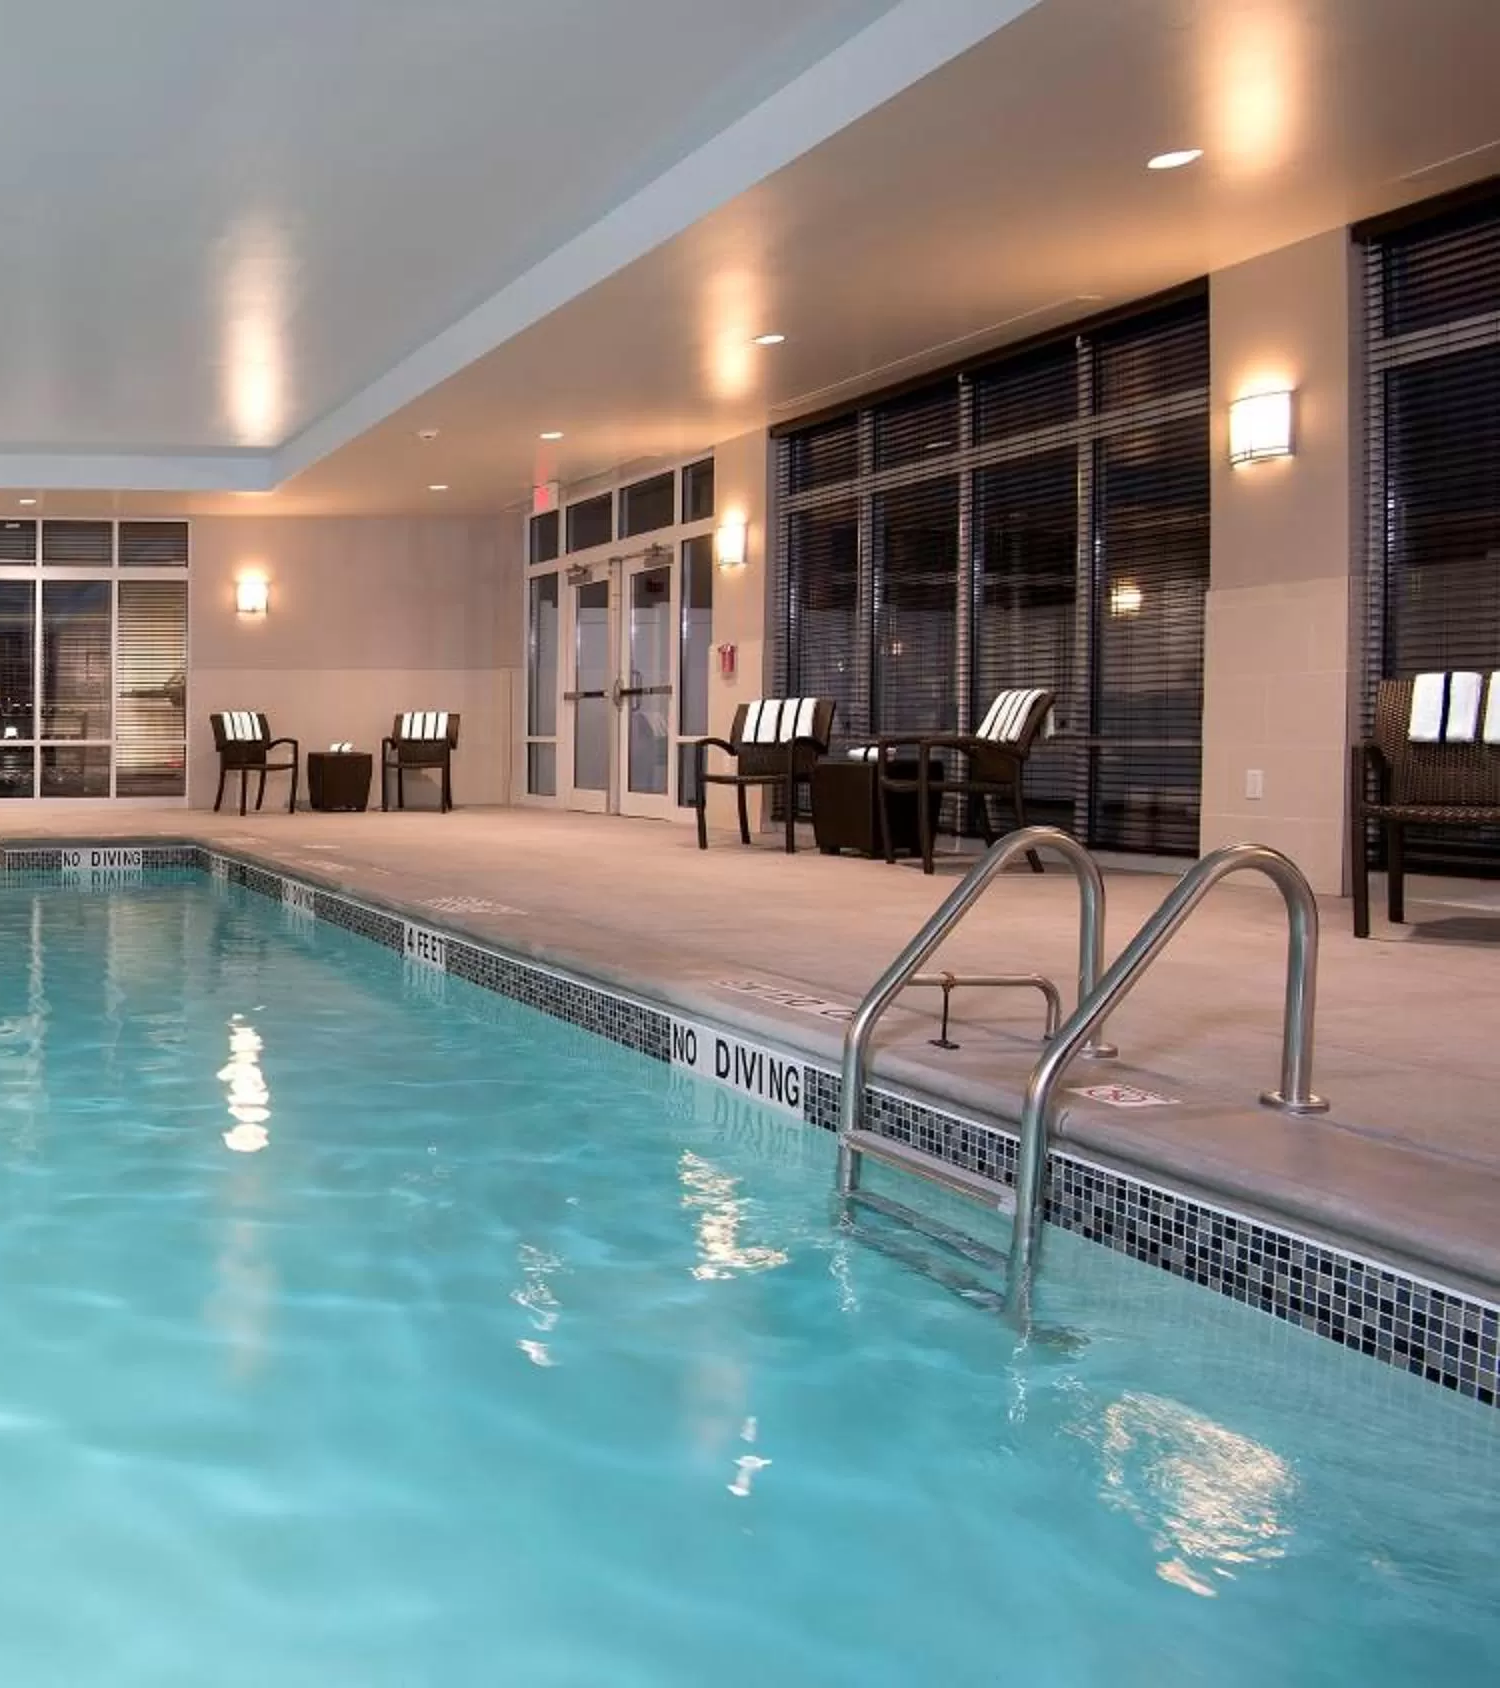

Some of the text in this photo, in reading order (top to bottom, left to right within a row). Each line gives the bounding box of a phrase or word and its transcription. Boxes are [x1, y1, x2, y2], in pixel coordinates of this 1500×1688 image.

[62, 850, 141, 867] NO DIVING
[417, 931, 445, 965] FEET
[672, 1023, 800, 1108] NO DIVING
